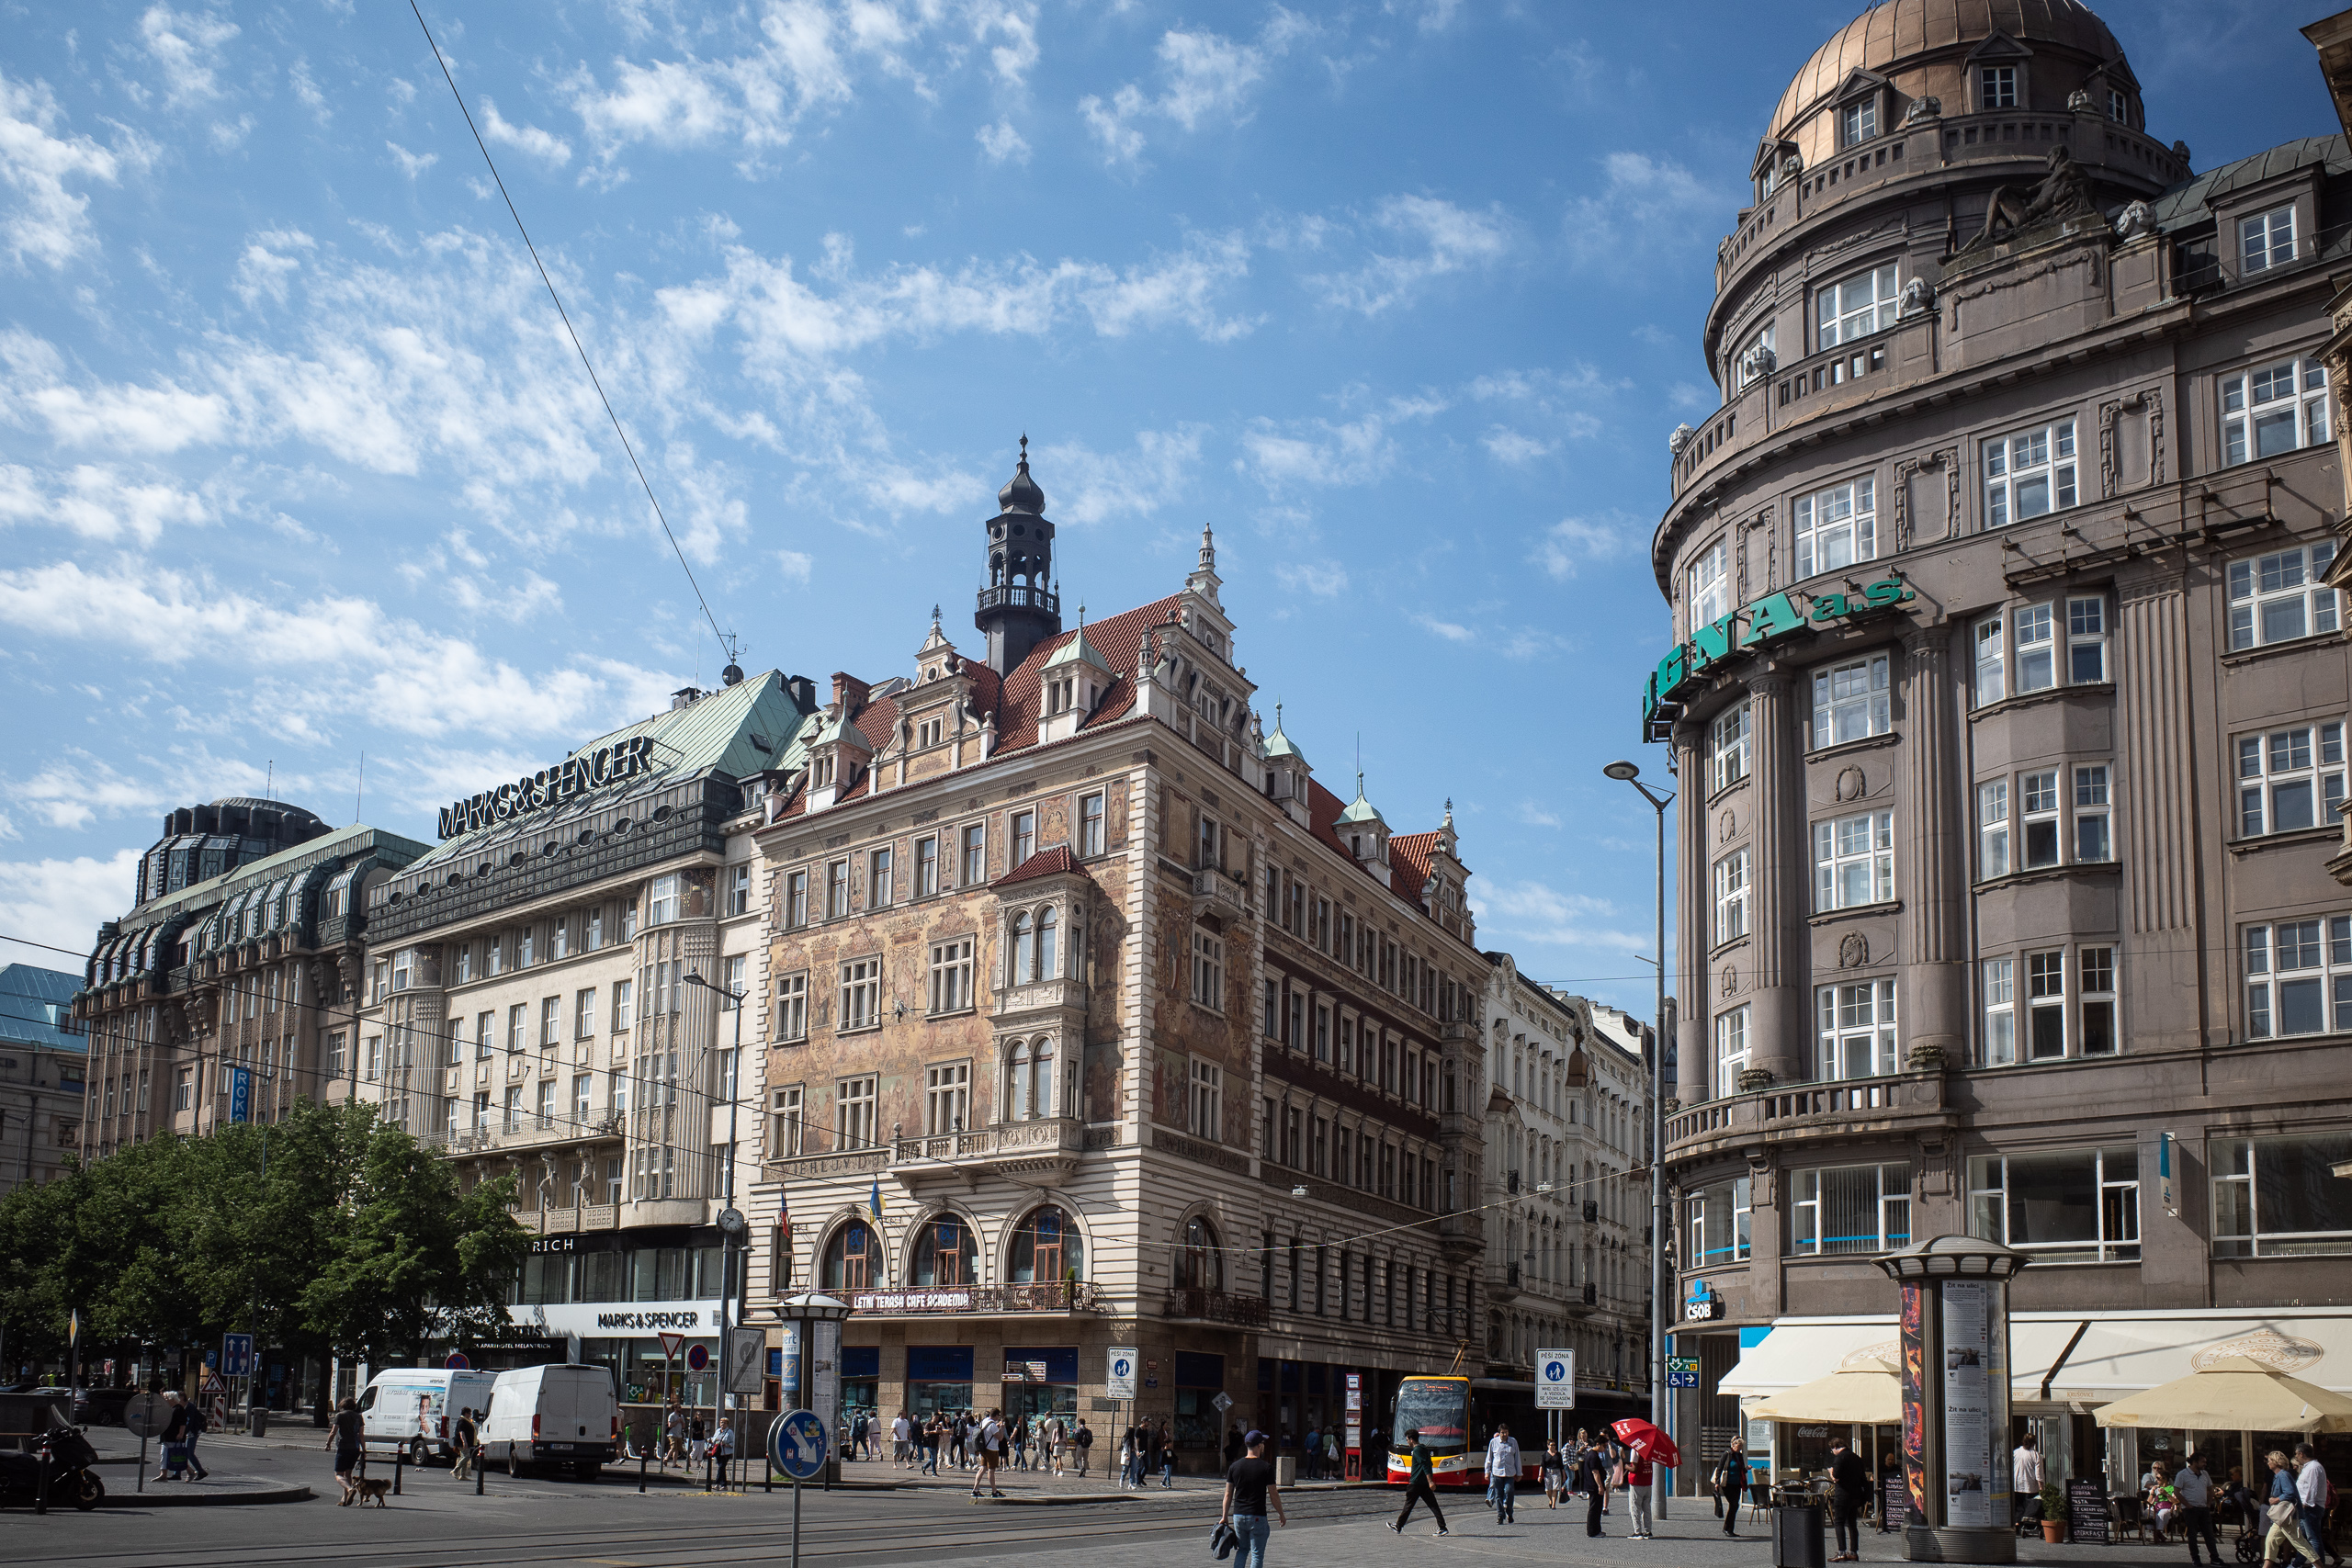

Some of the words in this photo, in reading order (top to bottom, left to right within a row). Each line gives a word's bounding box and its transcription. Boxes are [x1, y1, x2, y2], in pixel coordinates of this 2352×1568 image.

[1643, 592, 1808, 742] IGNA
[876, 1295, 904, 1309] TERASA
[926, 1293, 969, 1307] ACADEMIA
[1687, 1303, 1712, 1320] ČSOB
